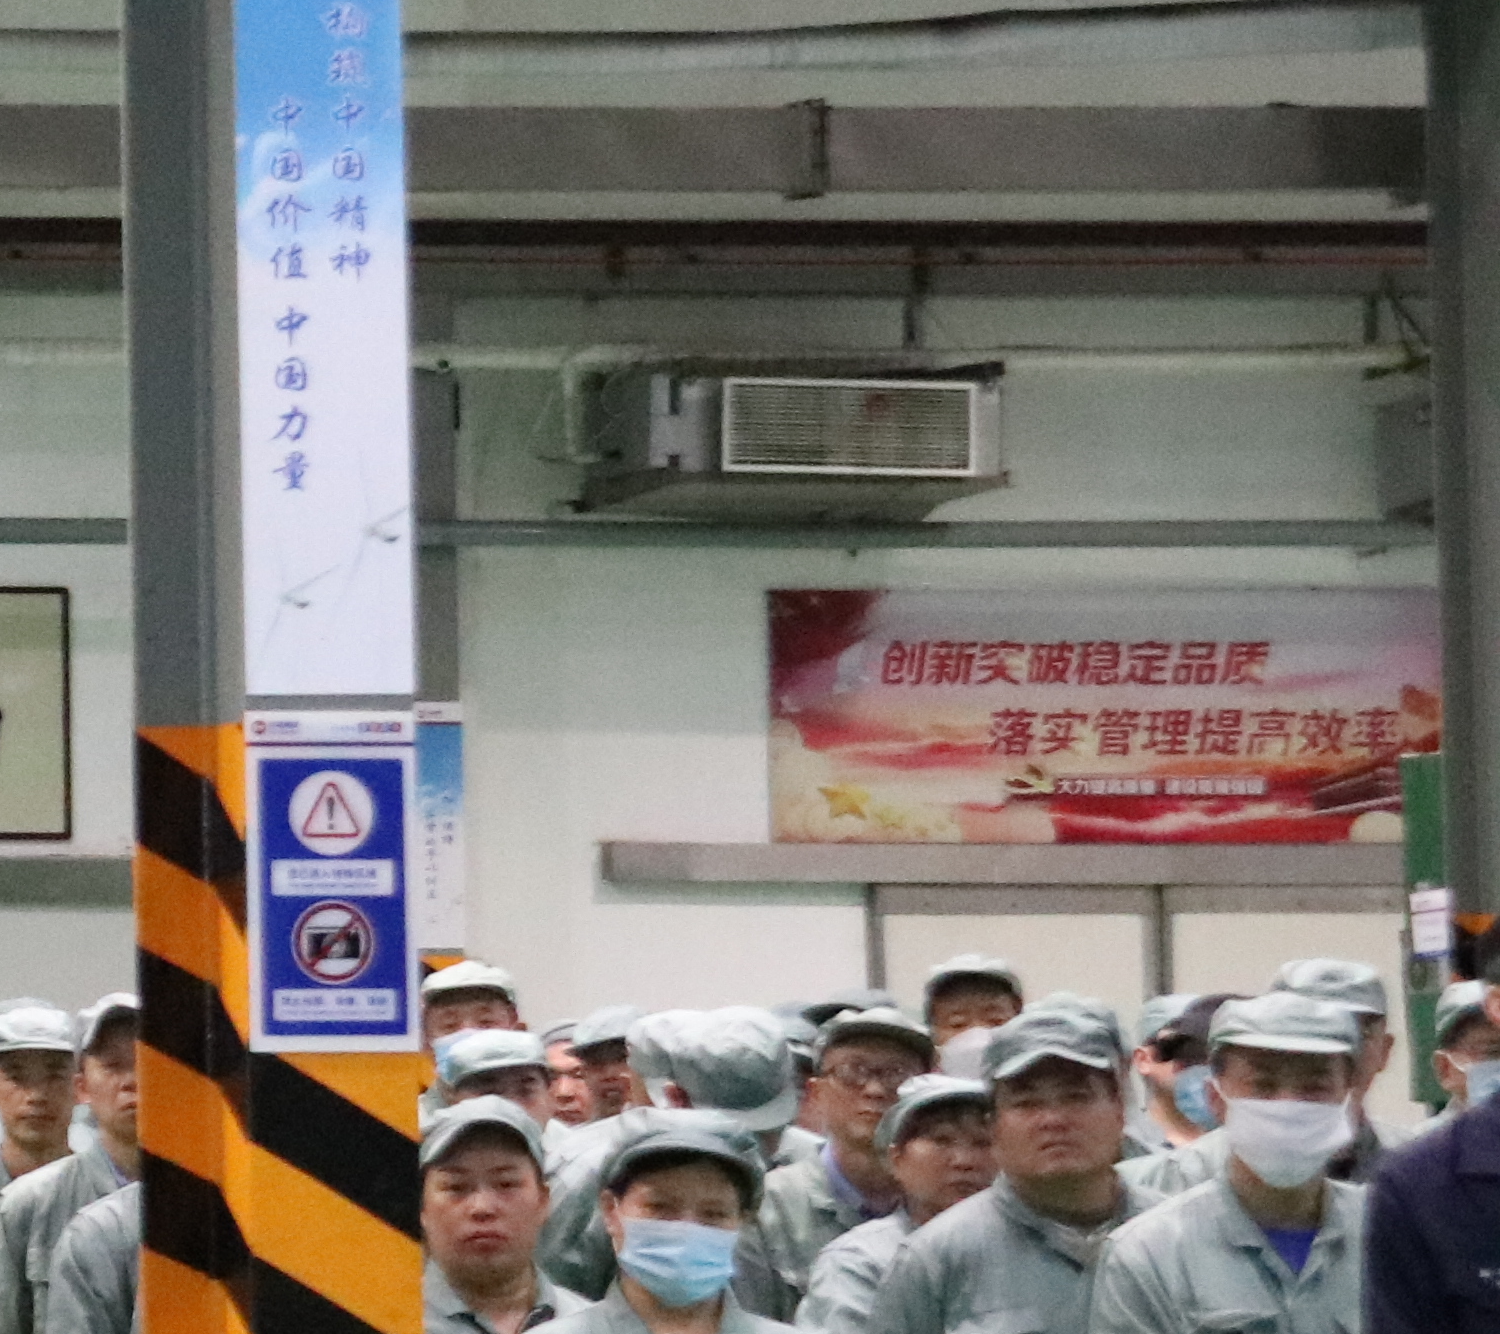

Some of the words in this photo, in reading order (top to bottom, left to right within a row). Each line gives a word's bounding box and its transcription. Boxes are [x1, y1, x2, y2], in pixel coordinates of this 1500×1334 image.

[880, 640, 1271, 687] 创新突破稳定品质
[988, 708, 1400, 757] 落实管理提高效率
